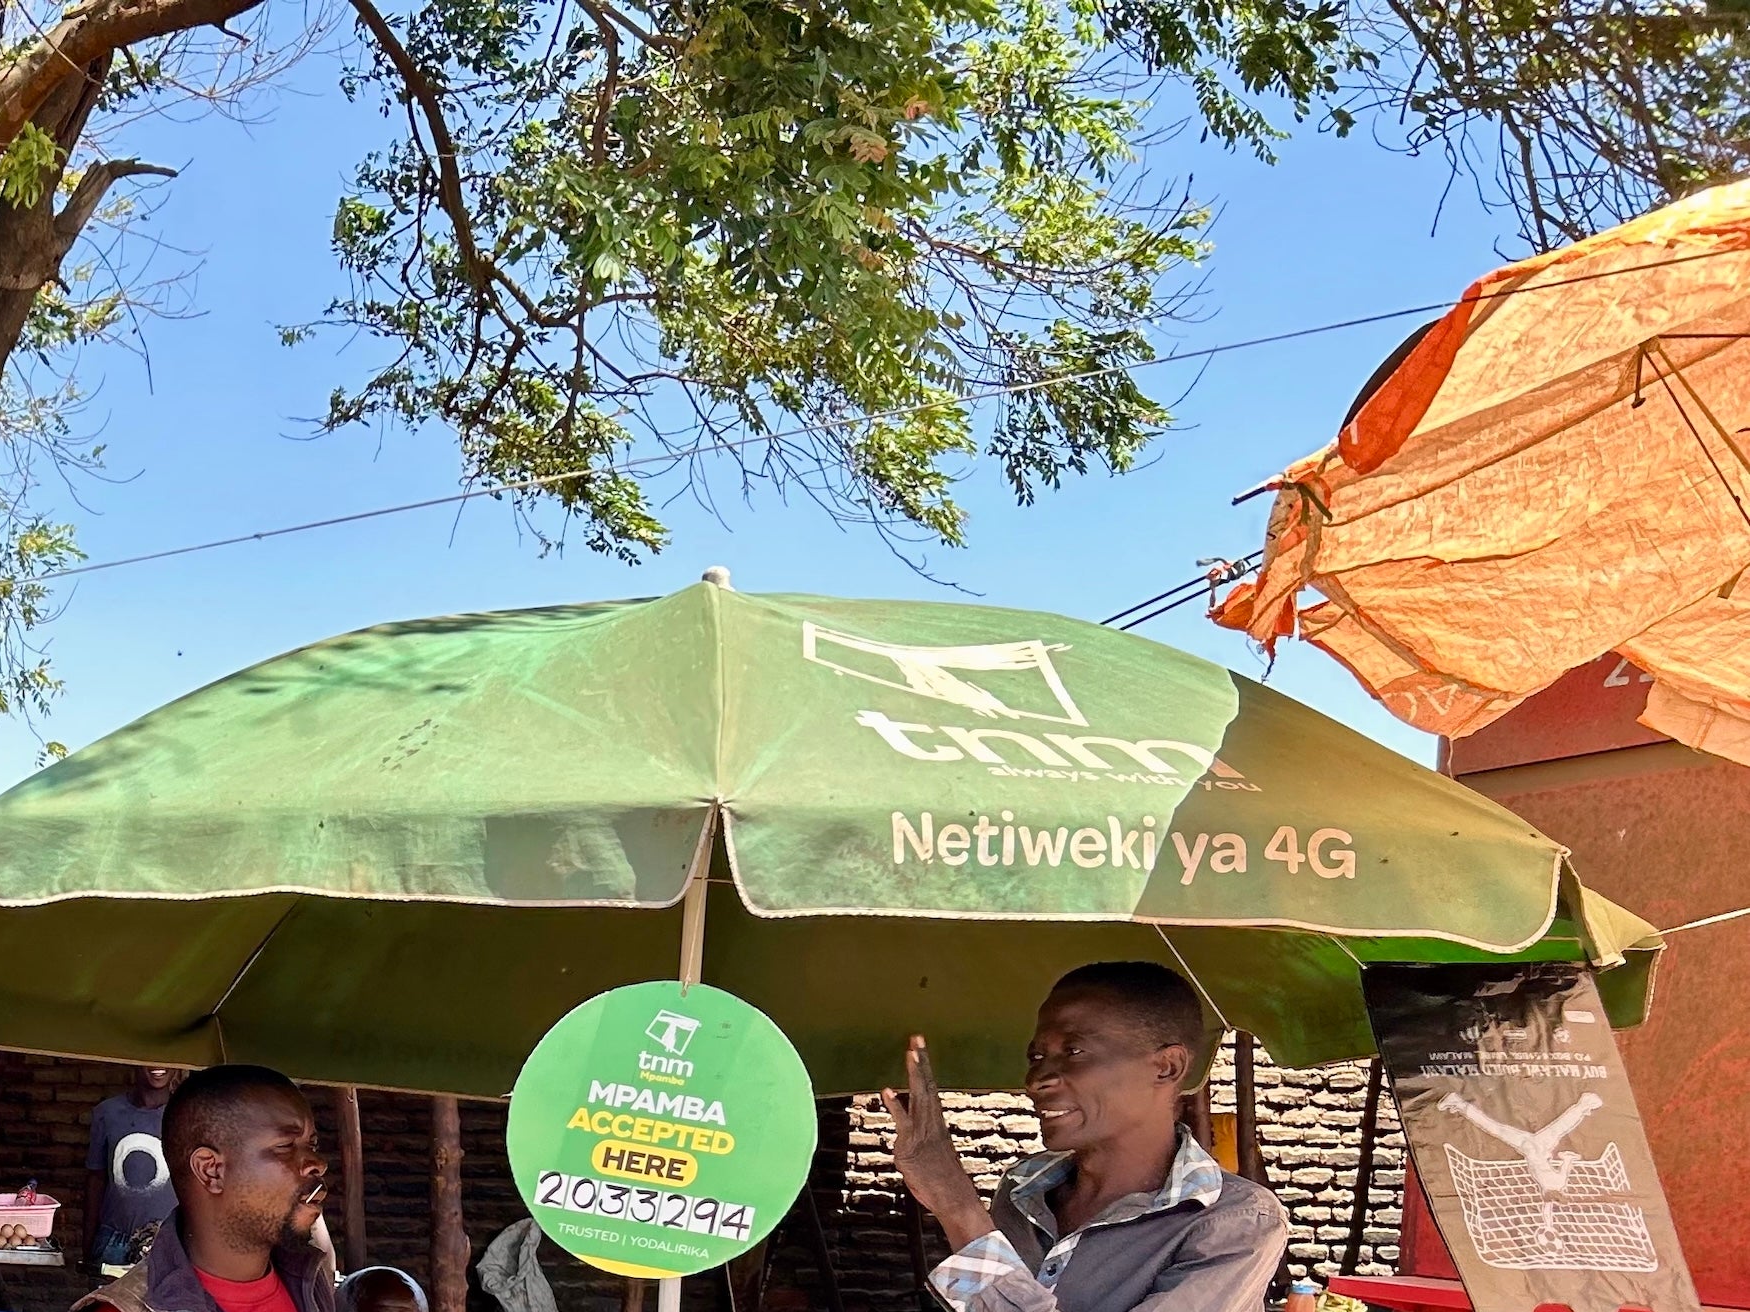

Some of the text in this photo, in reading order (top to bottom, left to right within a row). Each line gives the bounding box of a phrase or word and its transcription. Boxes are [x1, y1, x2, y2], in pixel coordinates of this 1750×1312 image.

[854, 709, 1246, 779] tnm
[986, 763, 1263, 793] always with you
[890, 809, 1357, 886] Netiweki ya 4G
[638, 1050, 694, 1078] tnm
[640, 1070, 686, 1086] Mpamba
[1480, 1063, 1521, 1078] BUILD
[1582, 1065, 1608, 1079] BUY
[587, 1079, 727, 1126] MPAMBA
[566, 1107, 736, 1155] ACCEPTED
[601, 1146, 689, 1182] HERE
[537, 1170, 752, 1241] 2033294
[557, 1222, 620, 1245] TRUSTED
[630, 1235, 711, 1260] YODALIRIKA
